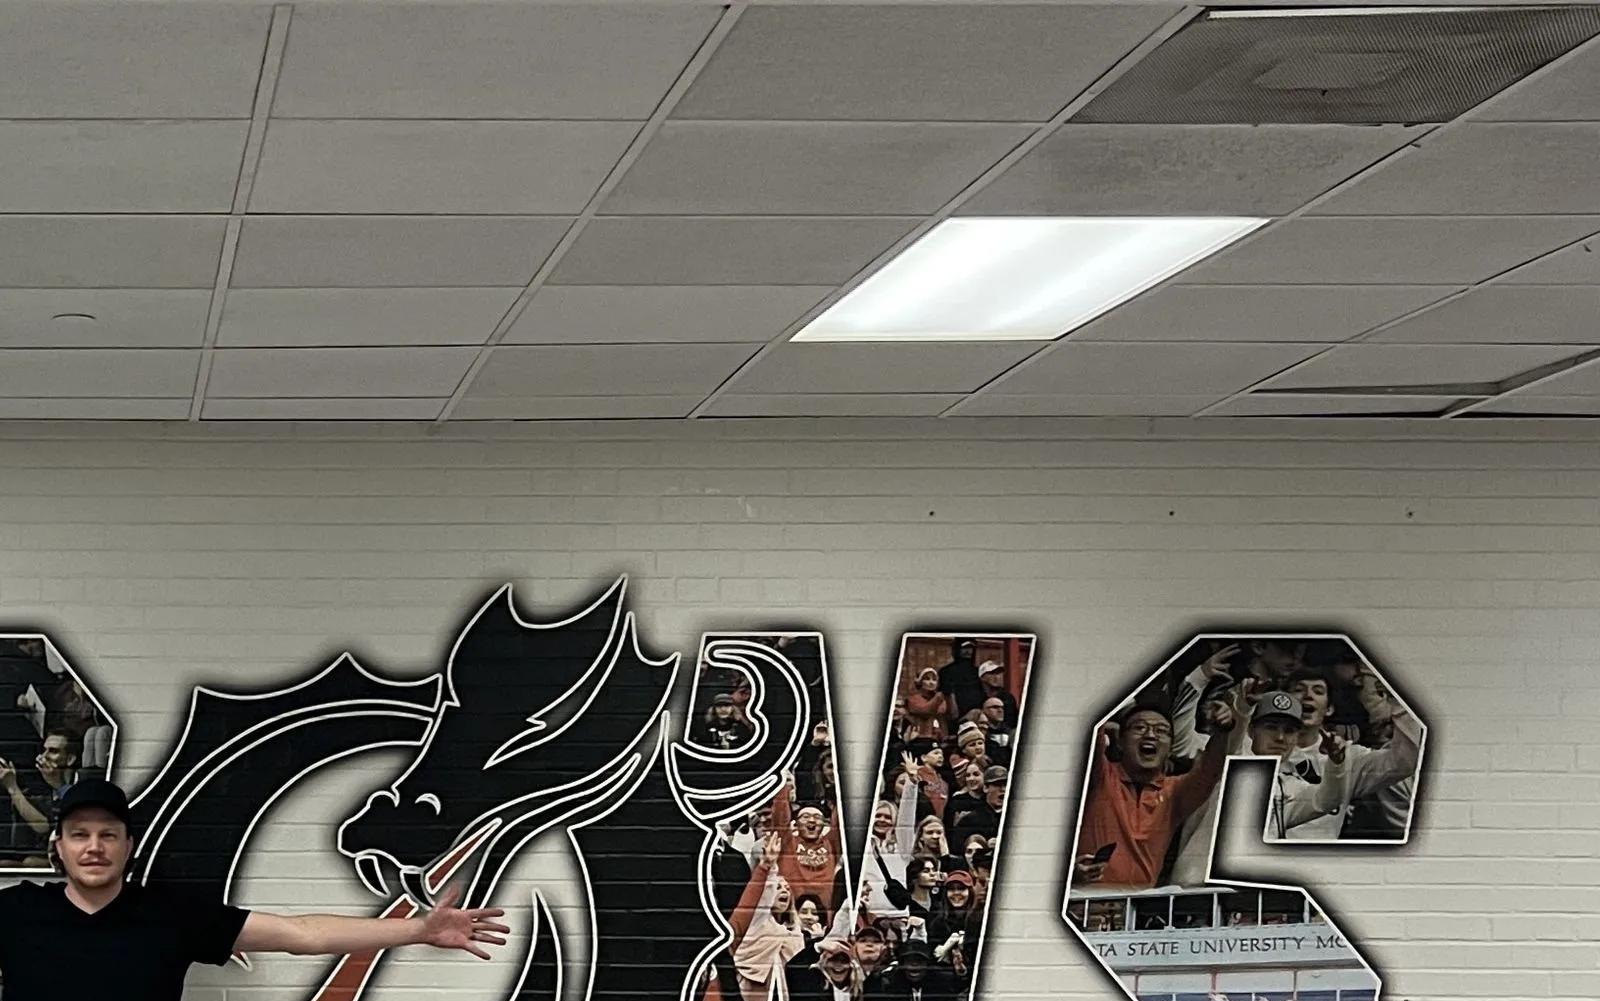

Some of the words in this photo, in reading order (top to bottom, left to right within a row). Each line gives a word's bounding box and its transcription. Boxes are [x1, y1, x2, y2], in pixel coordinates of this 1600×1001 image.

[1092, 943, 1118, 957] TA
[1127, 940, 1179, 957] STATE
[1190, 936, 1305, 954] UNIVERSITY
